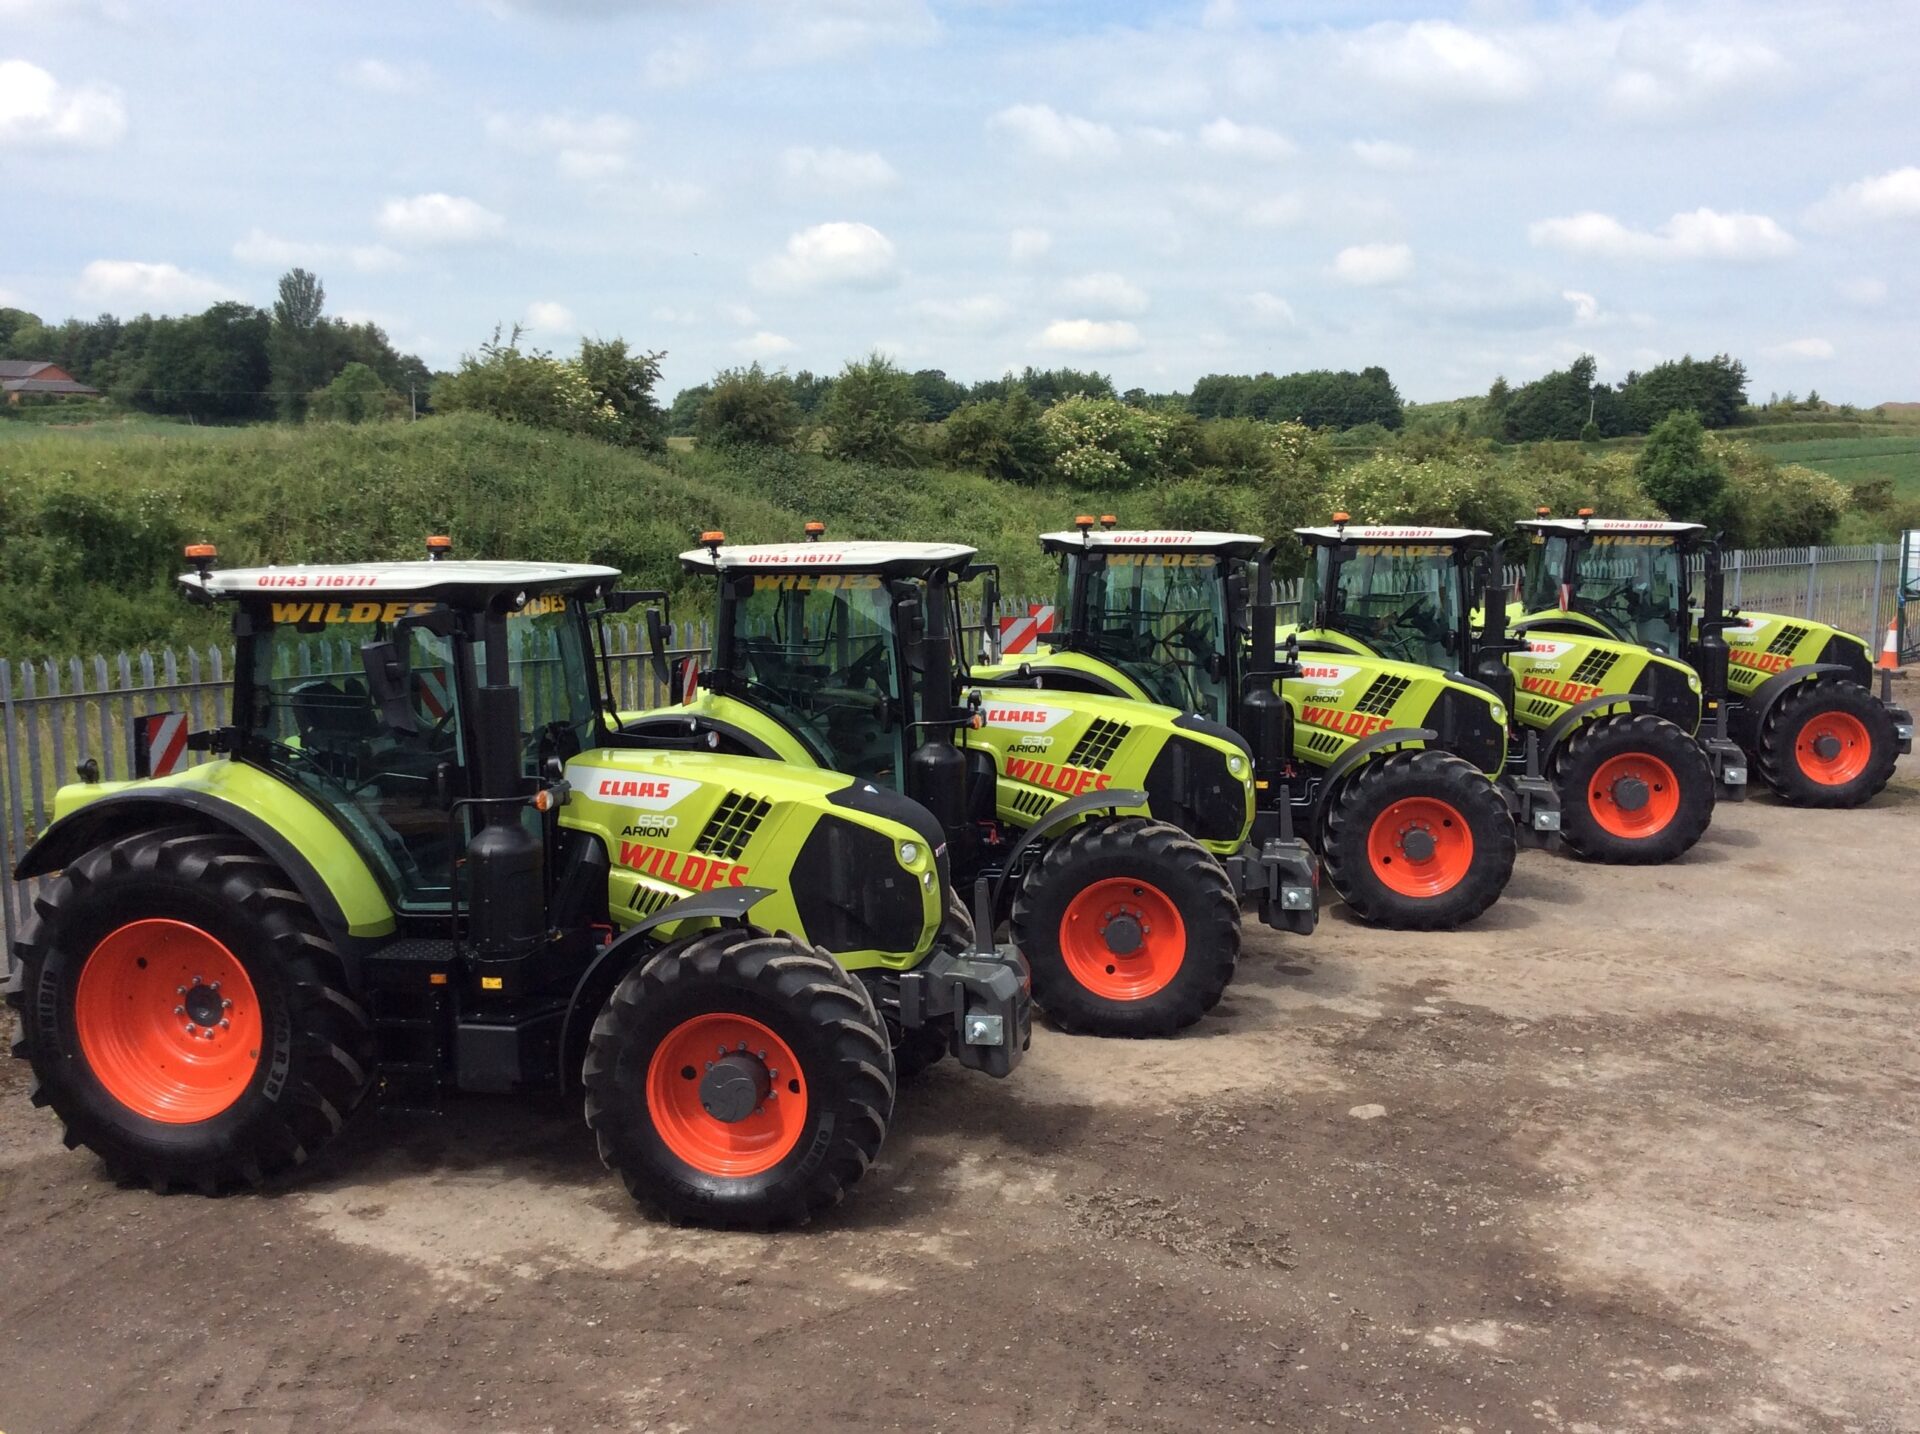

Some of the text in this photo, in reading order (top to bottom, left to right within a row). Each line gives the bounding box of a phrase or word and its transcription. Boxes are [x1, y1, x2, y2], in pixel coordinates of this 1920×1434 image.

[1593, 536, 1675, 545] WILDES
[748, 554, 842, 563] 01743 718777
[1106, 554, 1216, 567] WILDES
[258, 576, 377, 586] 01743 718777
[754, 575, 883, 590] WILDES
[988, 710, 1047, 723] CLAAS
[1007, 745, 1047, 753] ARION
[1005, 757, 1111, 797] WILDES
[599, 781, 670, 798] CLAAS
[638, 815, 678, 828] 650
[621, 826, 670, 838] ARION
[619, 841, 749, 892] WILDES
